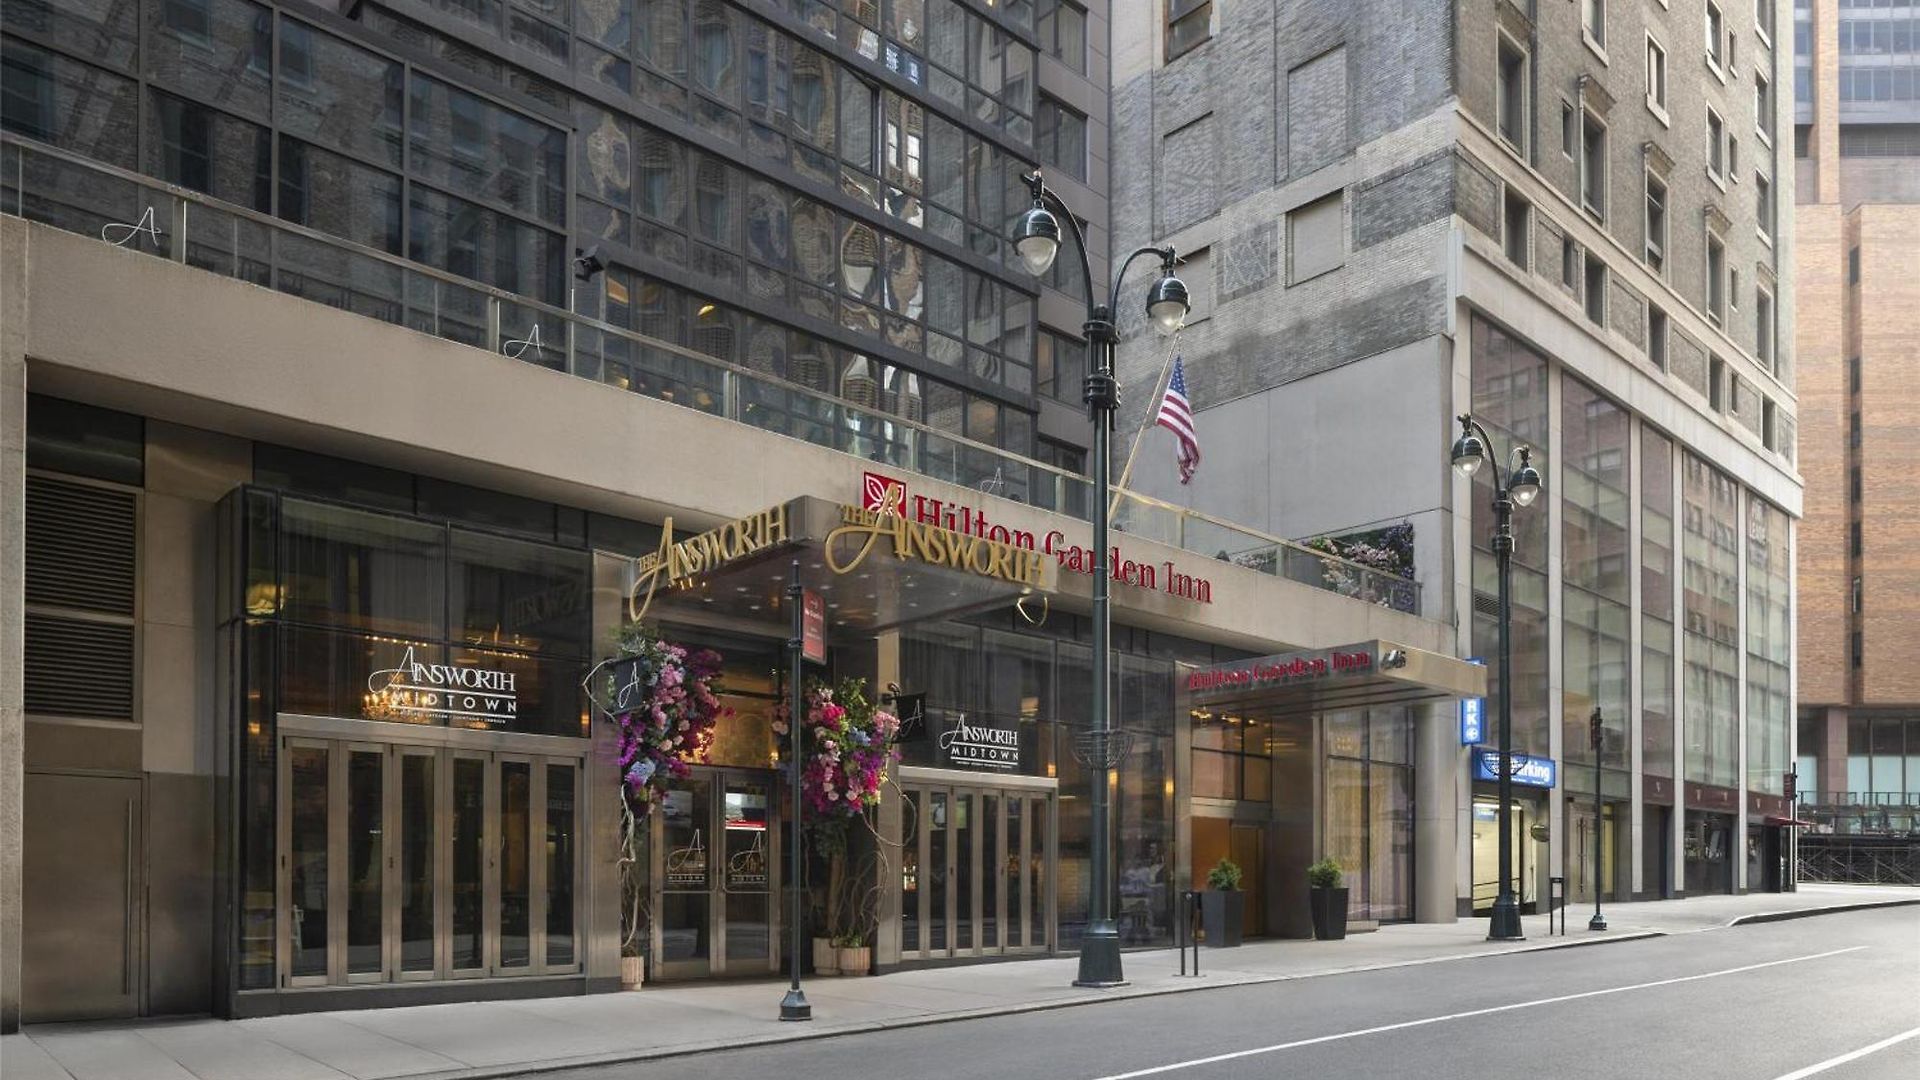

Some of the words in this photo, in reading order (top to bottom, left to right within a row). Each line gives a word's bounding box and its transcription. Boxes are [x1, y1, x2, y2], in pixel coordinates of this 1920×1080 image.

[840, 503, 876, 527] THE
[825, 482, 1049, 587] AINSWORTH
[913, 494, 1034, 551] Hilton
[1163, 561, 1213, 604] Inn
[630, 504, 788, 622] AINSWORTH
[638, 552, 658, 574] THE
[368, 646, 517, 695] AINSWORTH
[1188, 669, 1250, 691] Hilton
[1252, 657, 1327, 682] Garden
[1330, 651, 1371, 672] Inn
[391, 691, 517, 713] MIDTOWN
[939, 714, 1018, 750] AINSWORTH
[951, 747, 1020, 762] MIDTOWN
